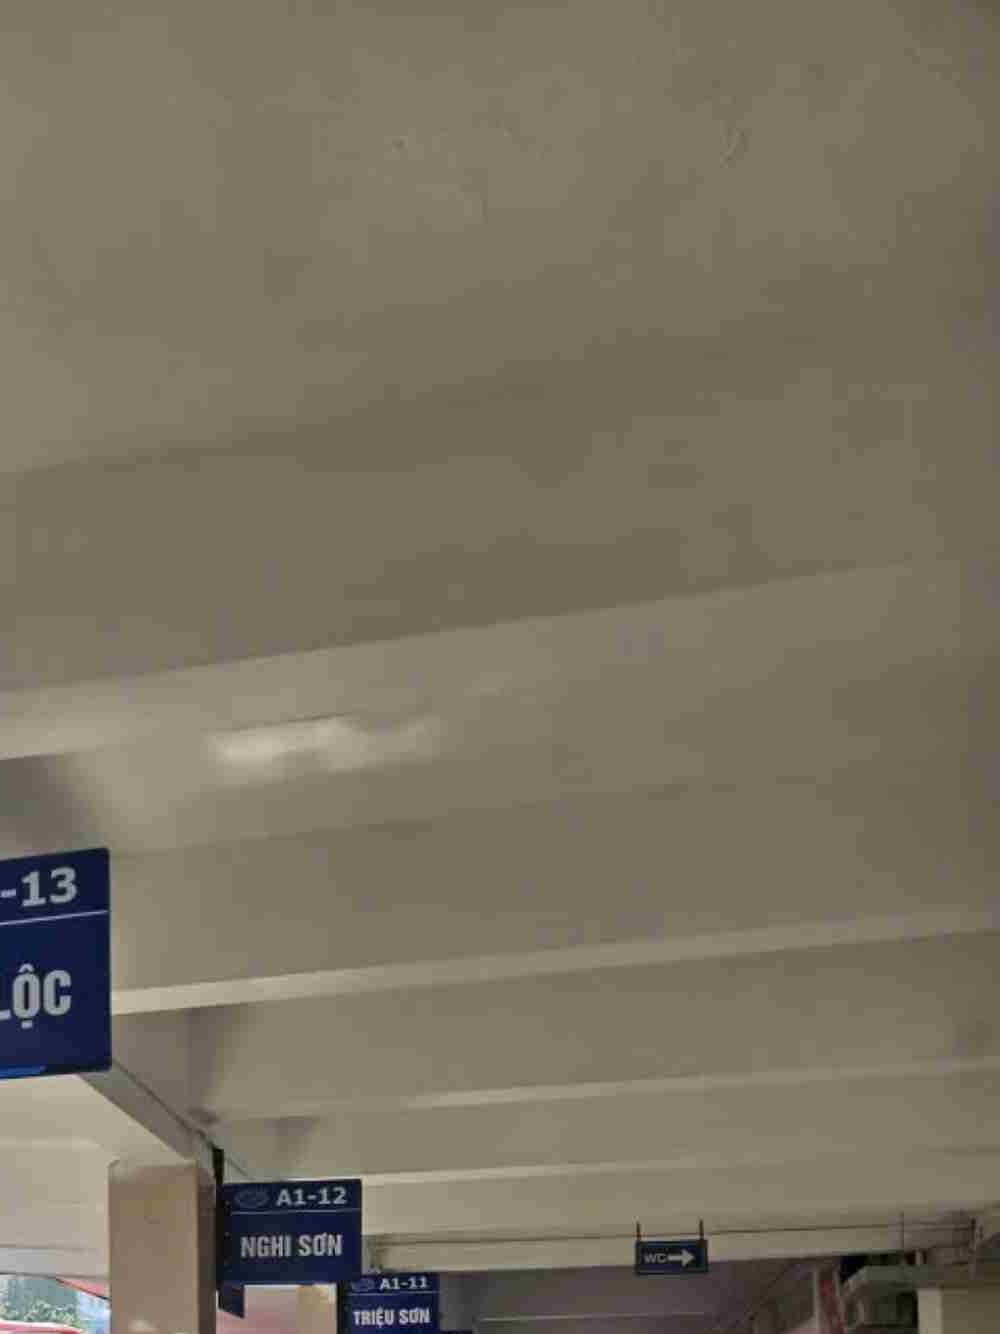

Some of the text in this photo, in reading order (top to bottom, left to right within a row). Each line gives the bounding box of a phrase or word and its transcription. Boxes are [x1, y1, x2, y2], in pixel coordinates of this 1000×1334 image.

[276, 1186, 347, 1207] A1-12
[240, 1231, 343, 1258] NGHI SƠN
[643, 1252, 667, 1264] WC
[379, 1276, 428, 1290] A1-11
[353, 1306, 430, 1328] TRIỆU SƠN
